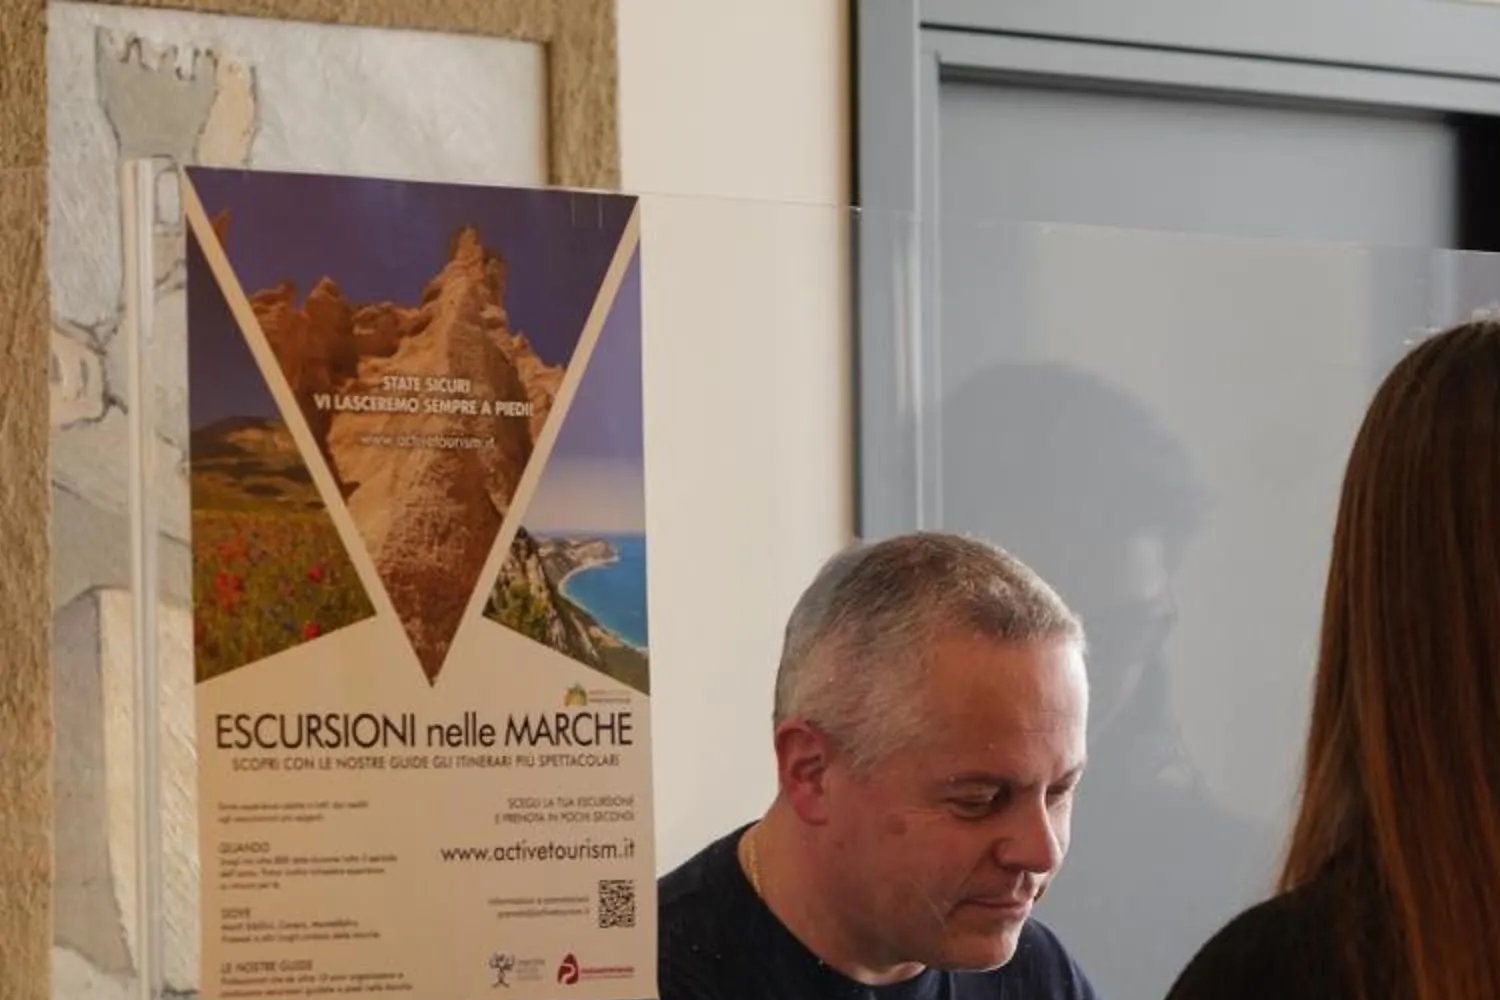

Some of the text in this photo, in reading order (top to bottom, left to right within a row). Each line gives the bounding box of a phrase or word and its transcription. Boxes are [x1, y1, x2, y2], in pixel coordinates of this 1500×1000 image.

[383, 376, 471, 393] STATE SICURI
[313, 394, 331, 410] VI
[334, 395, 419, 413] LASCEREMO
[424, 399, 478, 416] SEMPRE
[480, 400, 493, 416] A
[215, 711, 633, 750] ESCURSIONI nelle MARCHE
[231, 757, 280, 772] SCOPRI
[283, 757, 315, 771] CON
[319, 757, 333, 770] LE
[336, 756, 385, 770] NOSTRE
[389, 755, 429, 769] GUIDE
[433, 755, 453, 769] GLI
[456, 755, 513, 769] ITINERARI
[538, 753, 620, 768] SPETTACOLARI
[440, 837, 635, 861] www.activetourism.it
